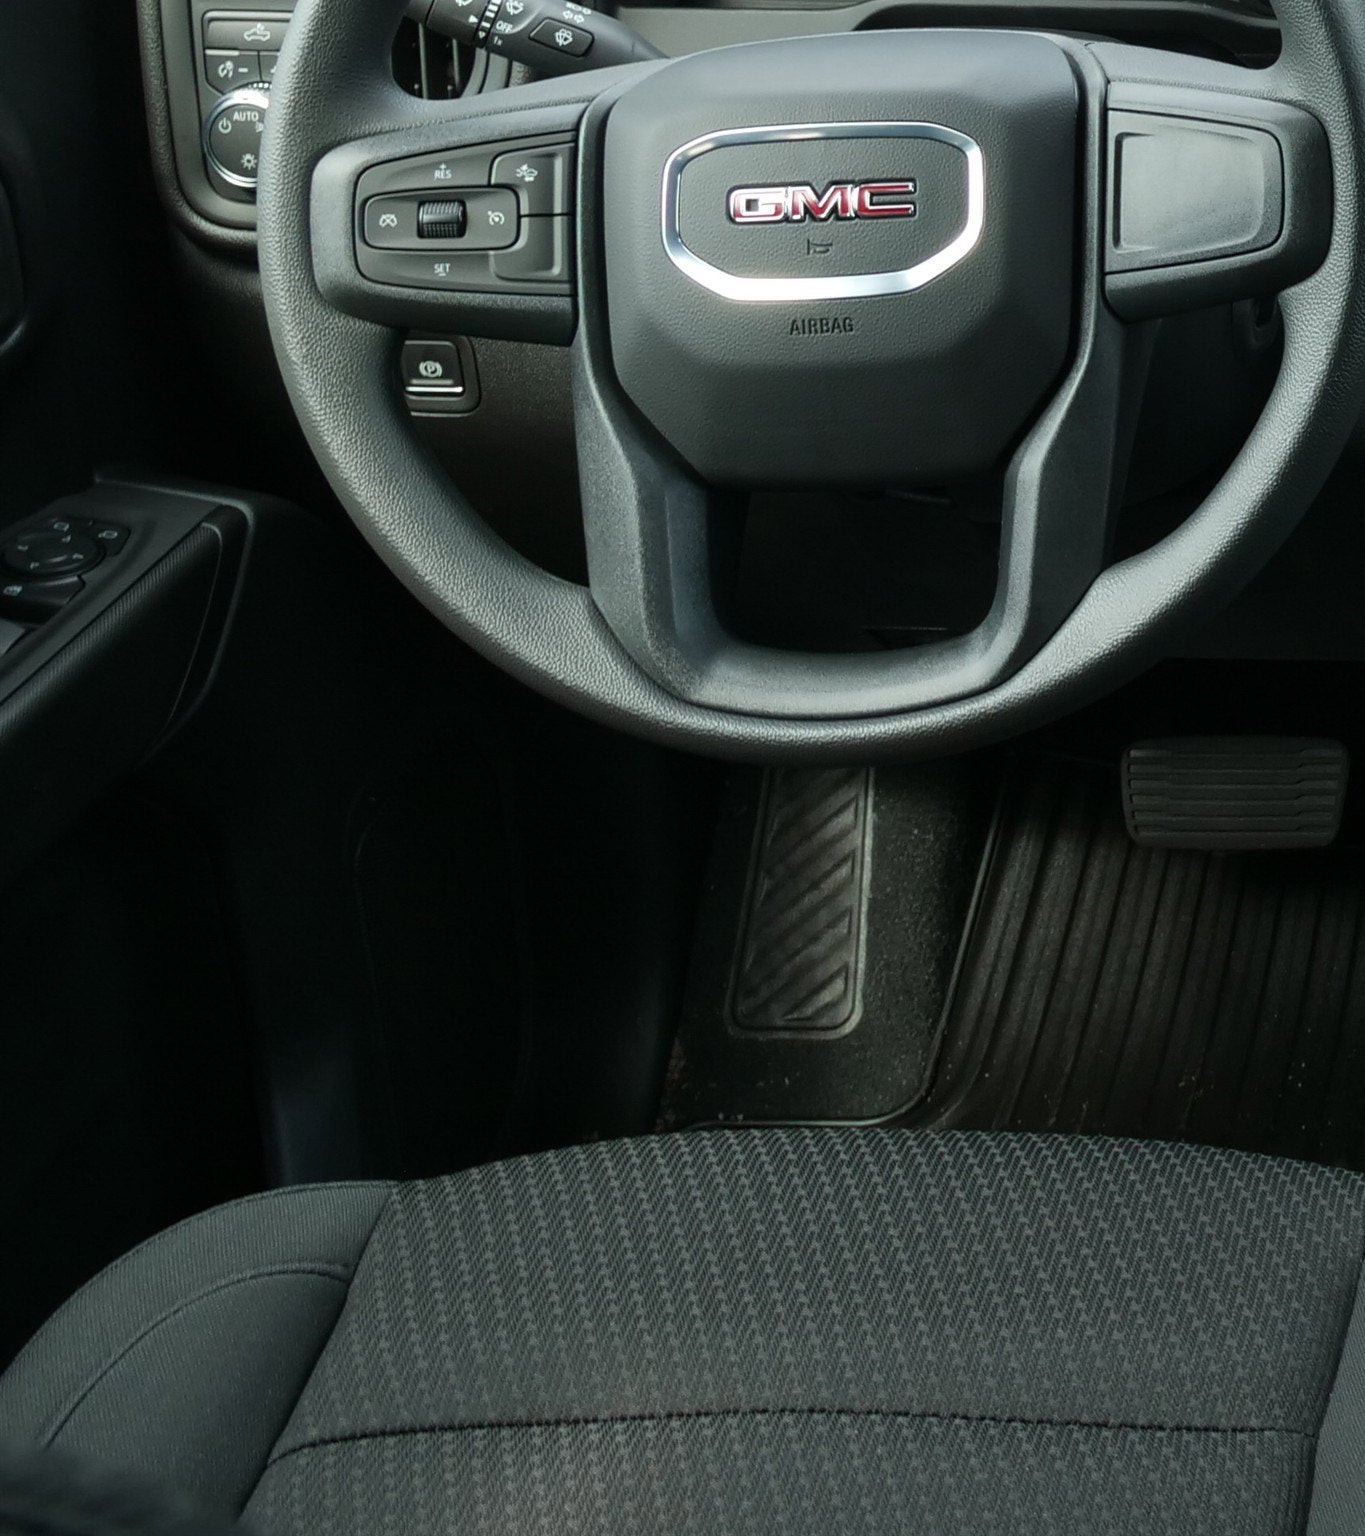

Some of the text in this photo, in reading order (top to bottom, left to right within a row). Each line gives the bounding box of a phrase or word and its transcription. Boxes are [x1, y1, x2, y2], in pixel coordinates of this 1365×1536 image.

[496, 20, 513, 33] OFF
[233, 111, 259, 122] AUTO
[434, 169, 452, 180] RES
[731, 180, 917, 224] GMC
[434, 263, 450, 273] SET
[789, 316, 854, 336] AIRBAG
